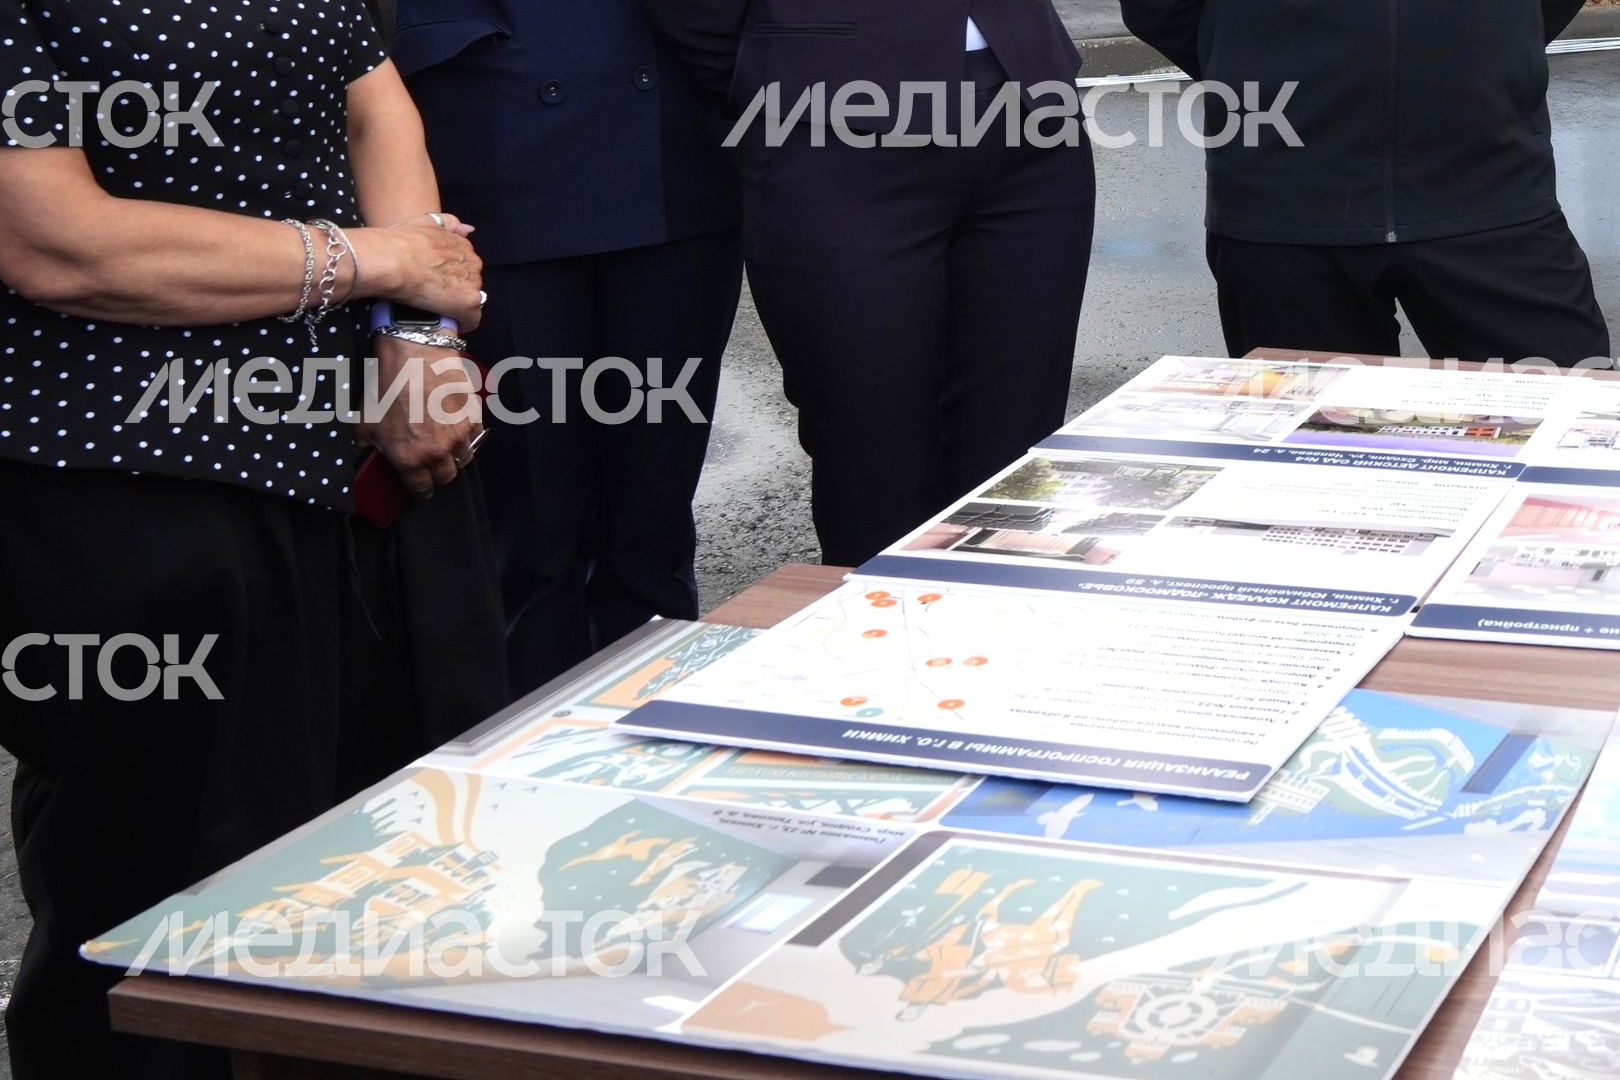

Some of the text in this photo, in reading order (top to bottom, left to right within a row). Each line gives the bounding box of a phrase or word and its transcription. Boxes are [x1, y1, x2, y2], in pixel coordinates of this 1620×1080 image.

[1207, 591, 1292, 604] КОЛЛЕДЖ
[1288, 597, 1395, 612] КАПРЕМОНТ
[839, 728, 1253, 781] РЕАЛИЗАЦИЯ ГОСПРОГРАММЫ В Г.О. ХИМКИ
